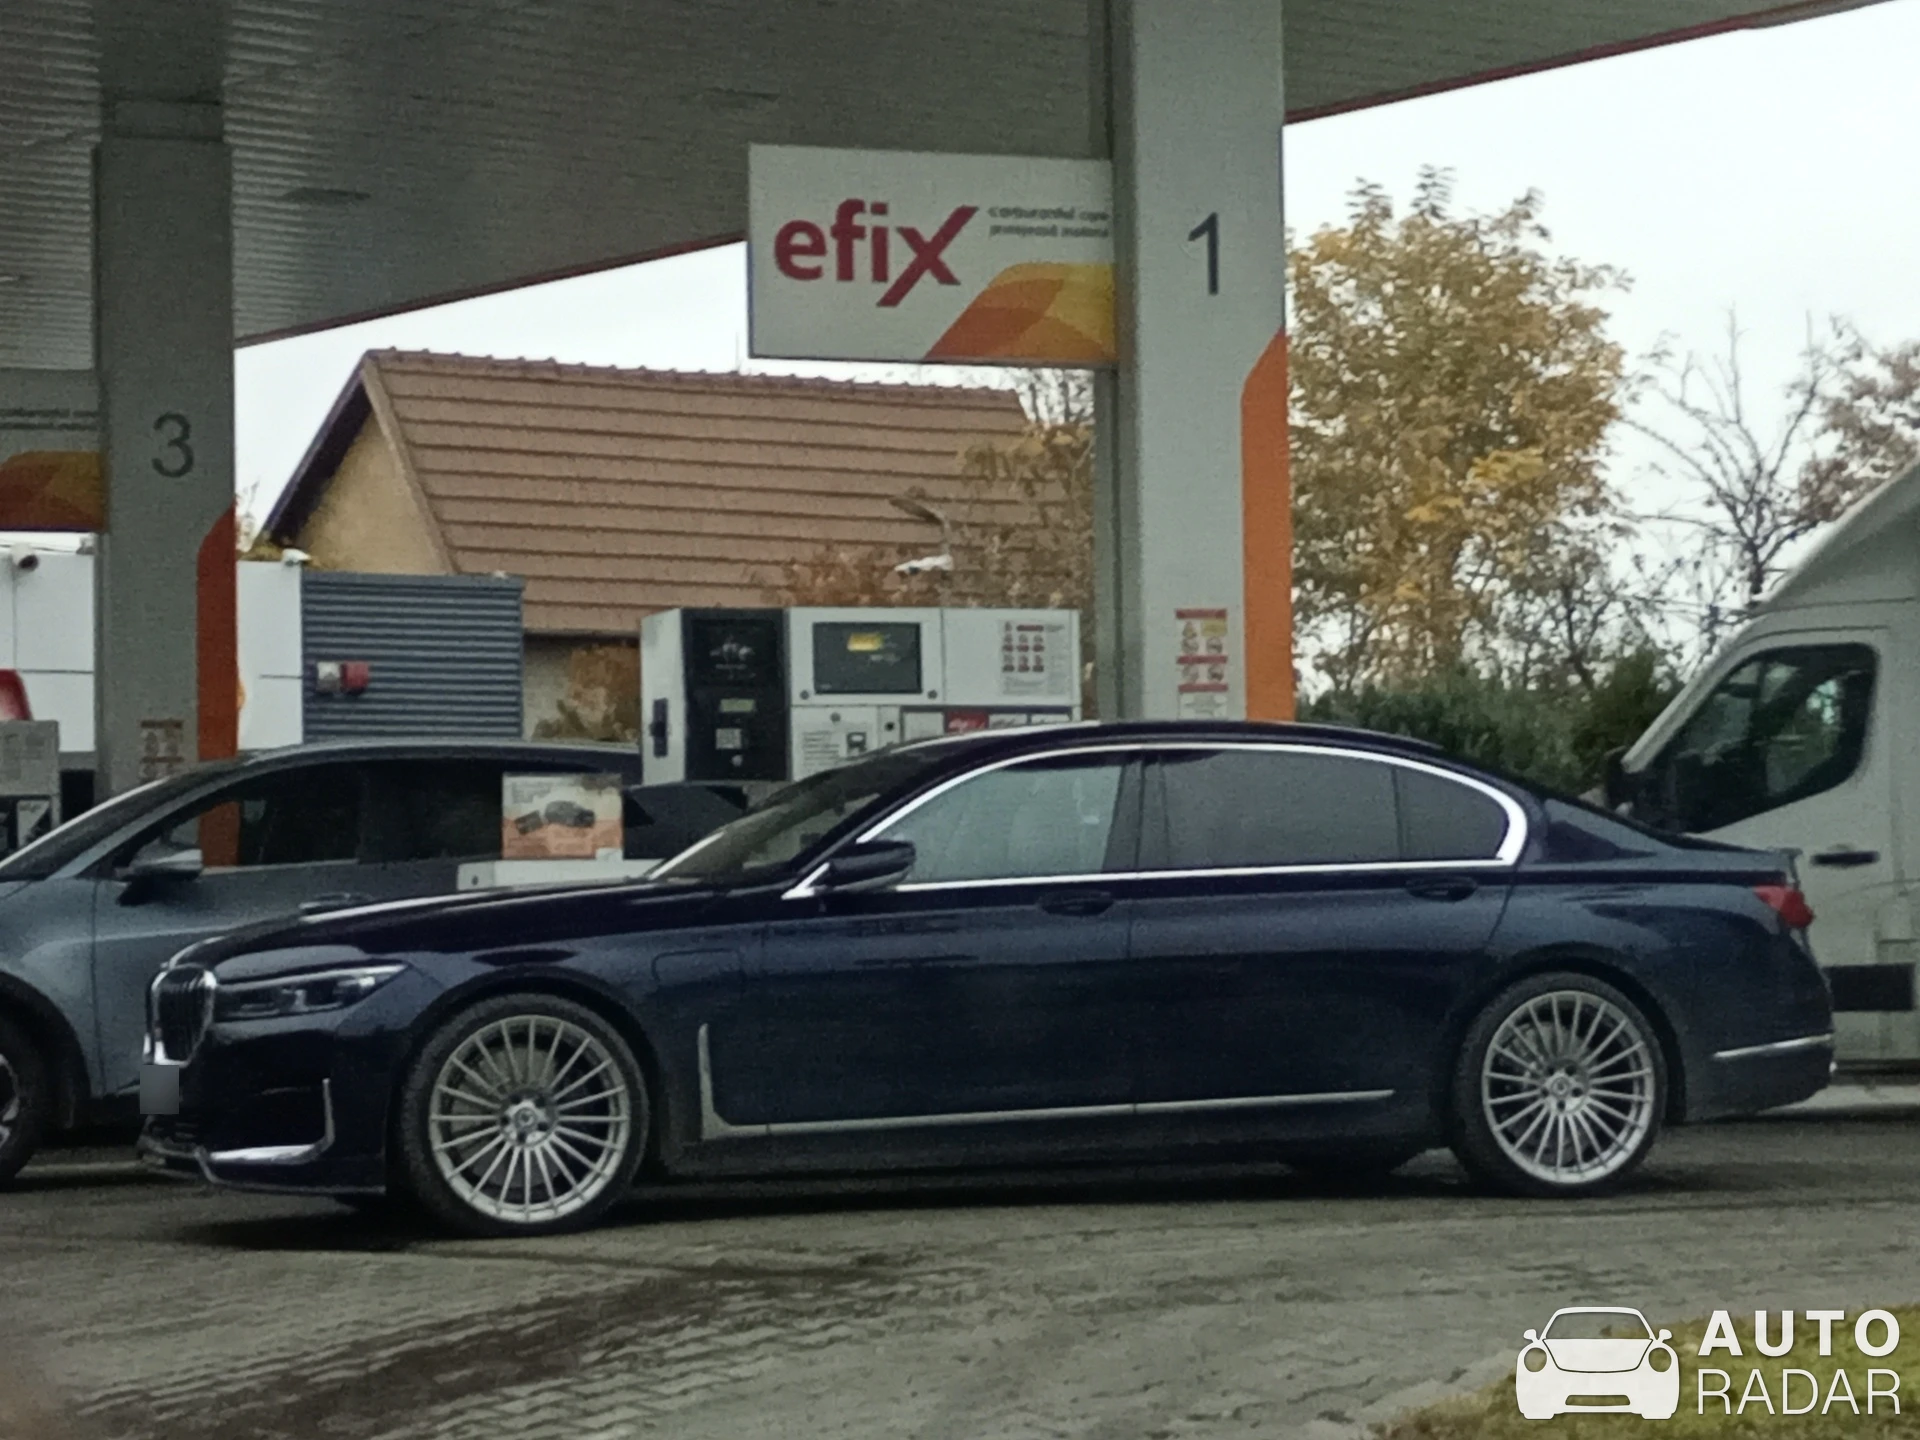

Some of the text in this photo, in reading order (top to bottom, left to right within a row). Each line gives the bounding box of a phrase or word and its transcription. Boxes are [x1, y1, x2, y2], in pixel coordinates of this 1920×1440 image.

[774, 198, 980, 307] efix
[1187, 212, 1219, 296] 1
[151, 412, 195, 479] 3
